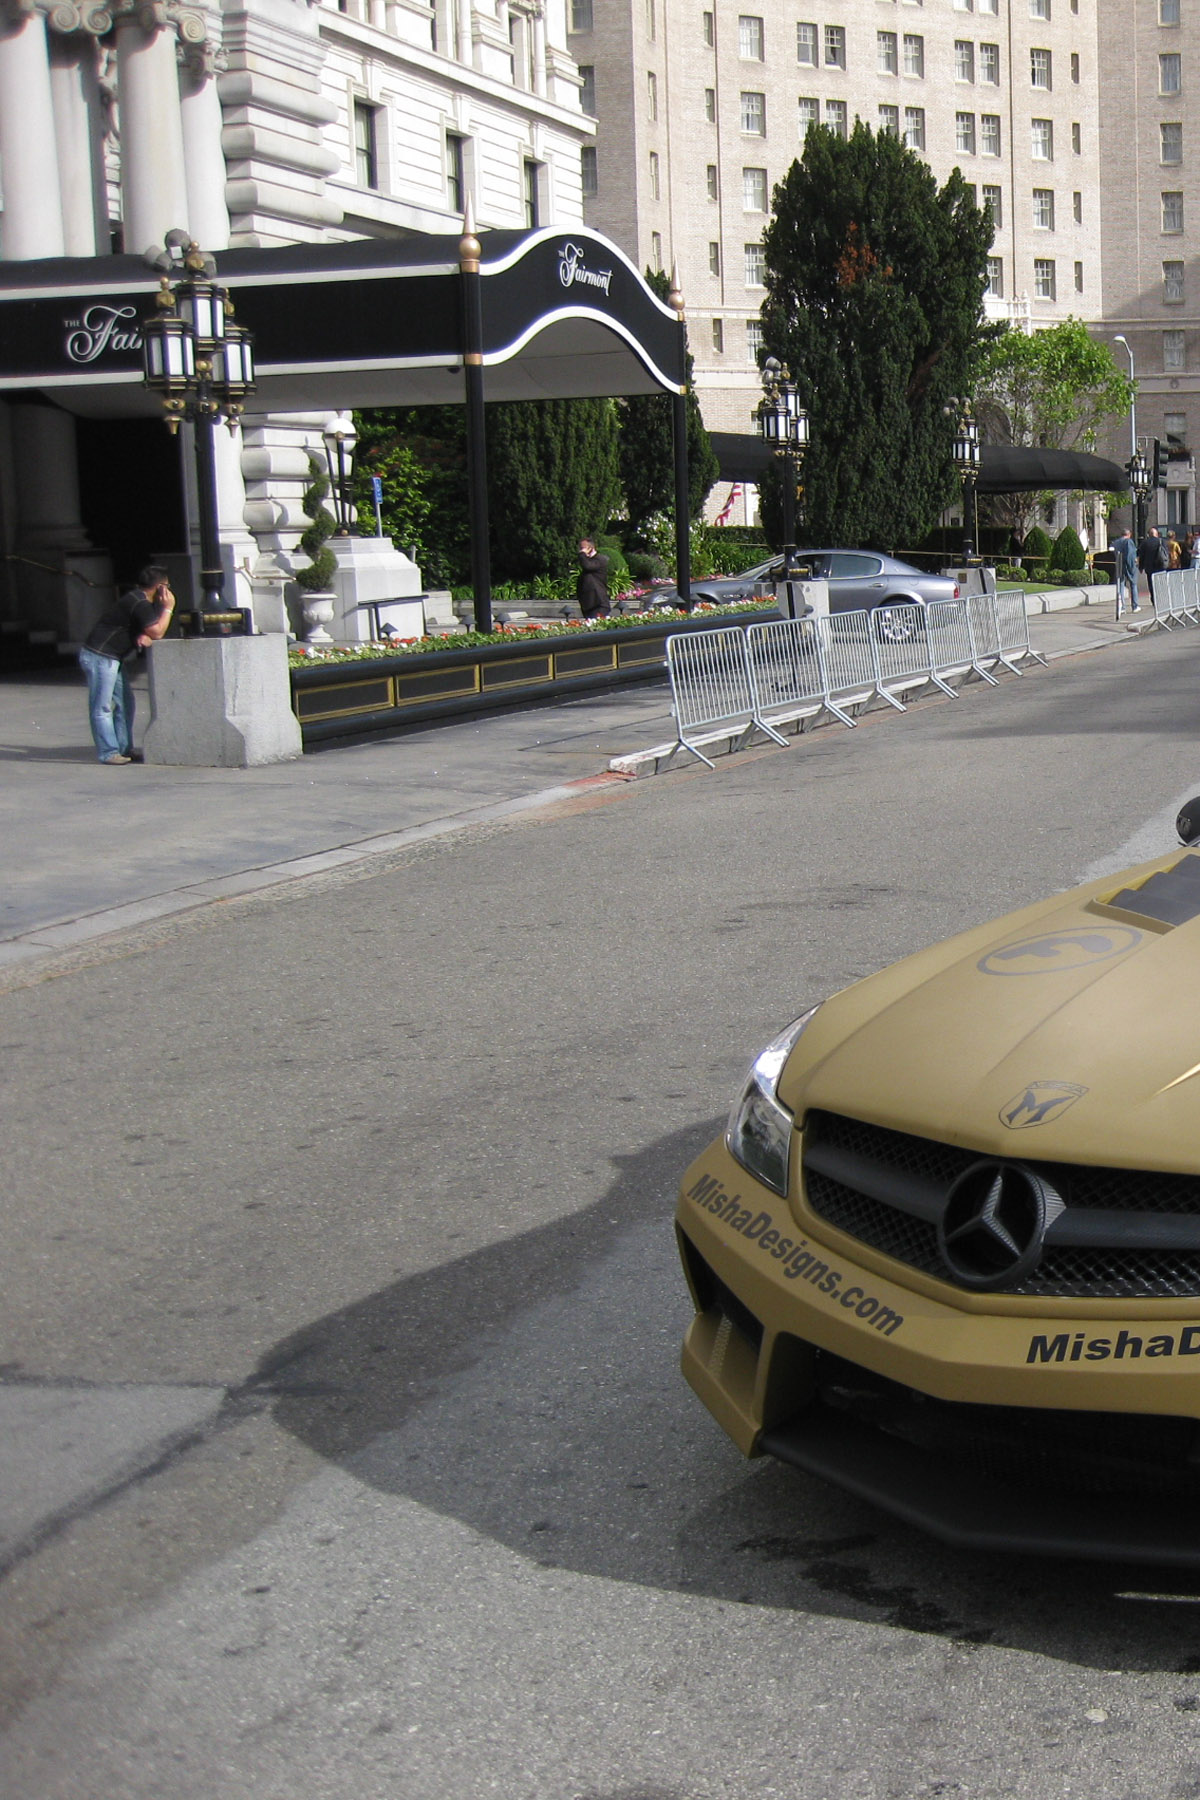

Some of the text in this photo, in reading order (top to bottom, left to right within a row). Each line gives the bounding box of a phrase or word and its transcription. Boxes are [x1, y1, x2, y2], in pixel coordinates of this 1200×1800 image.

[559, 243, 613, 297] Fairmont
[64, 320, 81, 328] THE
[687, 1173, 904, 1337] MishaDesigns.com
